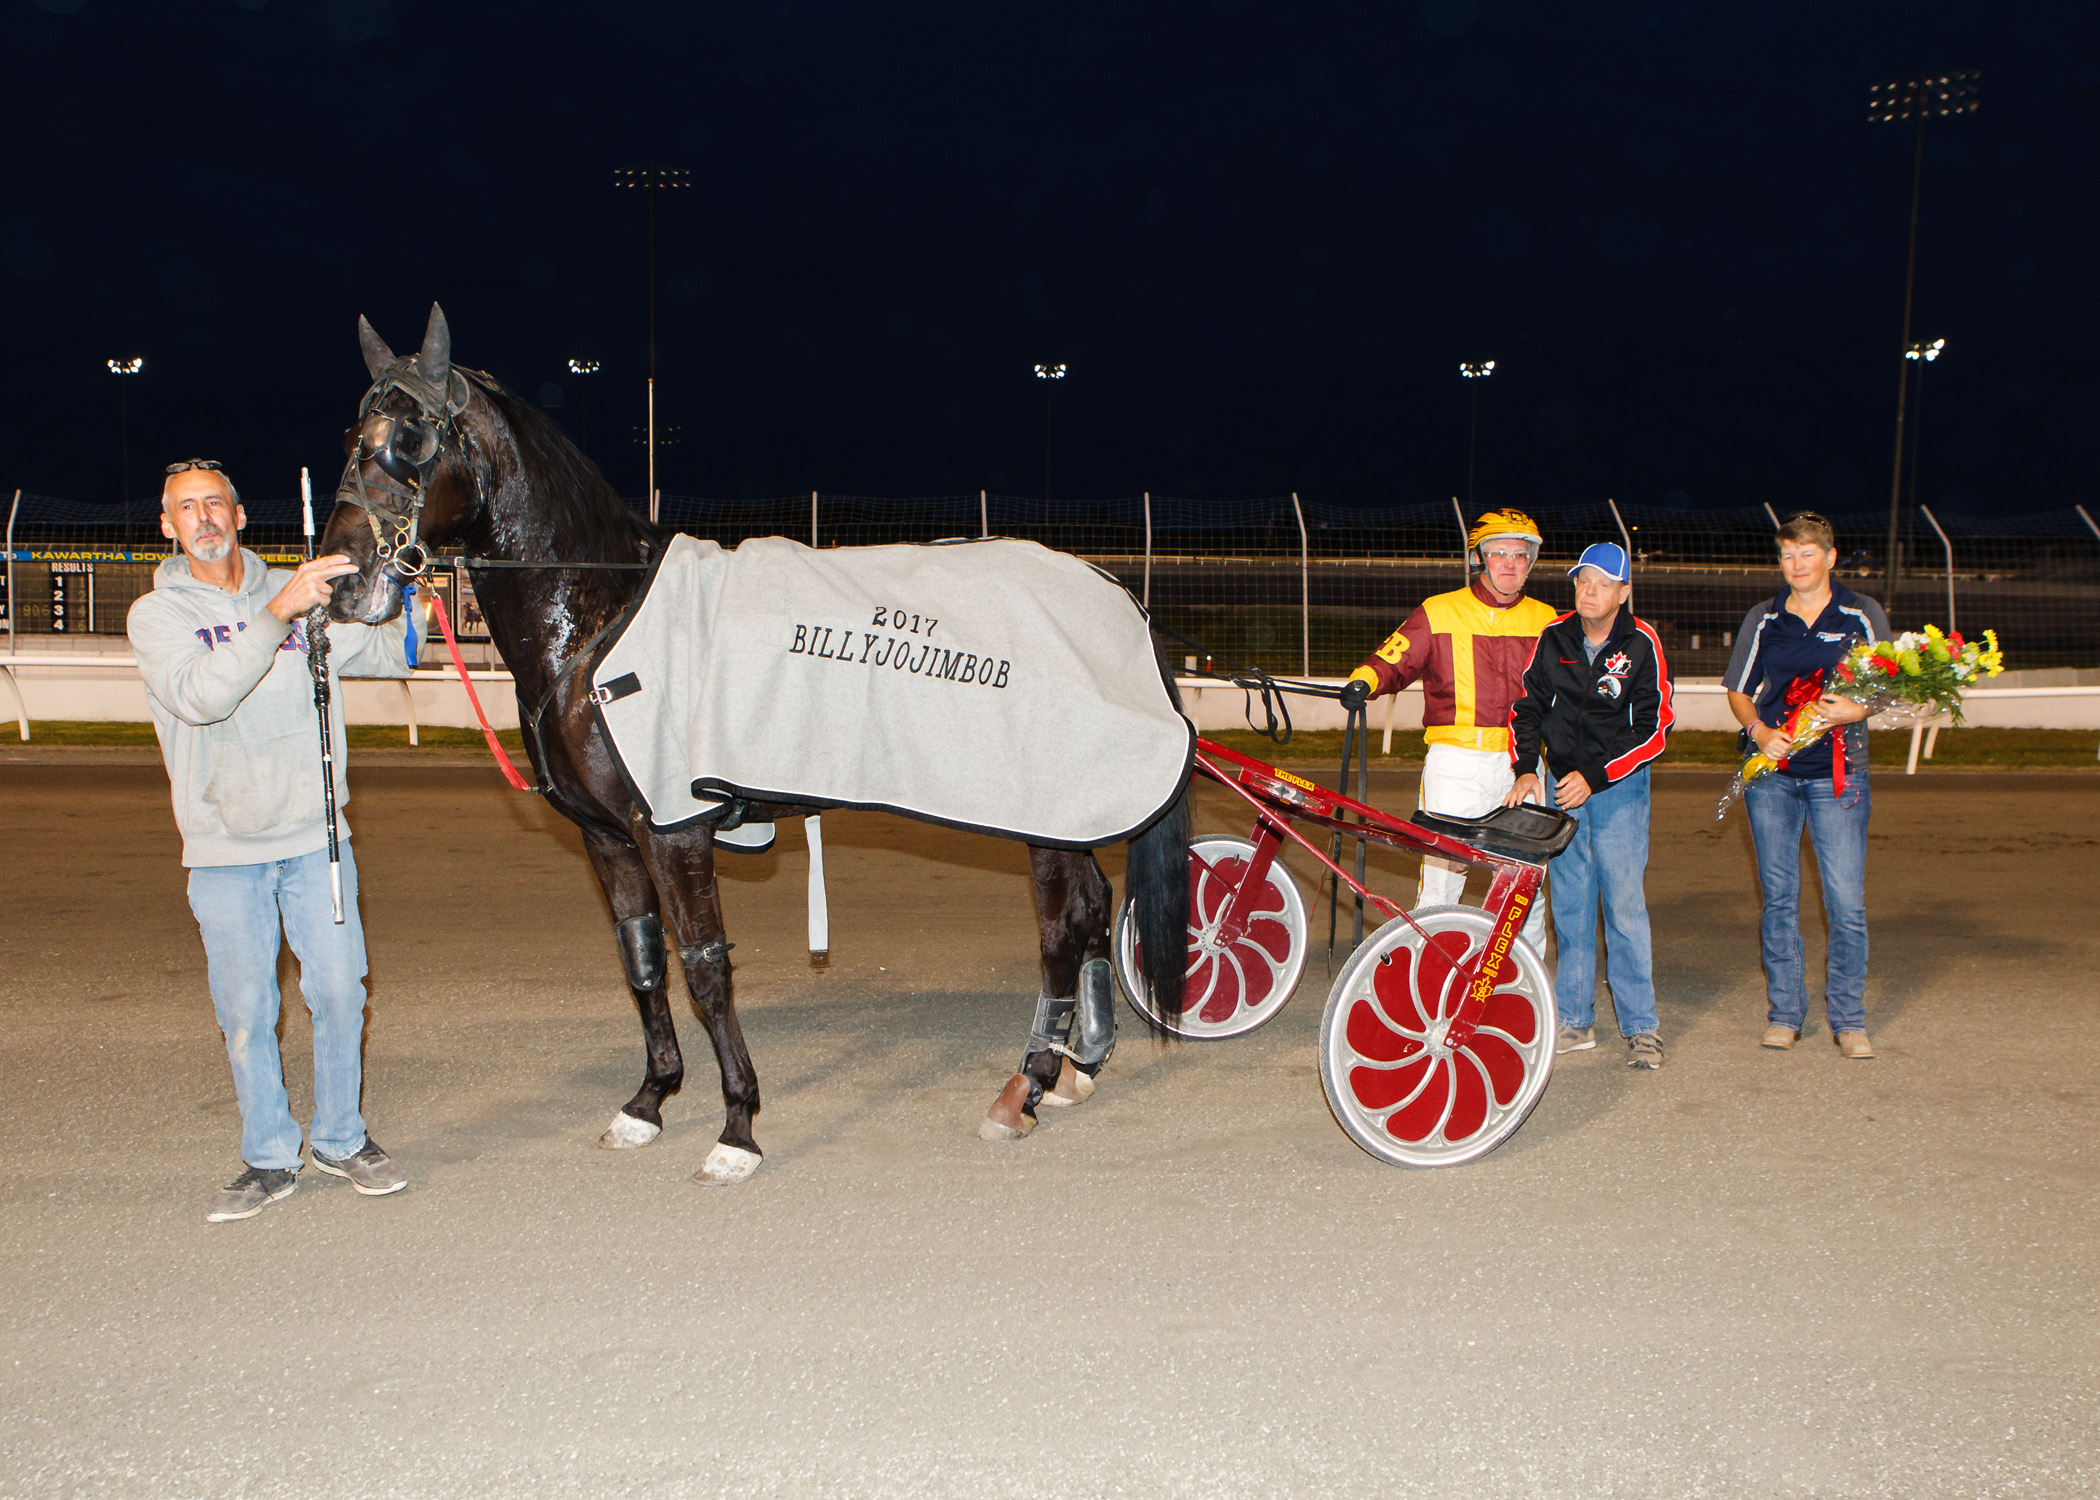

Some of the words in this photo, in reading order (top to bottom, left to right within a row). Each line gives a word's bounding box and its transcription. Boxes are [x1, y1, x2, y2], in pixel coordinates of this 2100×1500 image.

[31, 551, 126, 560] KAWARTHA
[51, 563, 94, 573] RESULTS
[54, 576, 63, 587] 1
[53, 590, 64, 601] 2
[53, 605, 64, 616] 3
[53, 619, 64, 631] 4
[872, 606, 939, 637] 2017
[789, 624, 1011, 689] BILLYJOJIMBOB
[1274, 768, 1293, 782] THE
[1292, 775, 1315, 791] FLEX
[1514, 894, 1529, 906] THE
[1487, 906, 1522, 969] FLEX
